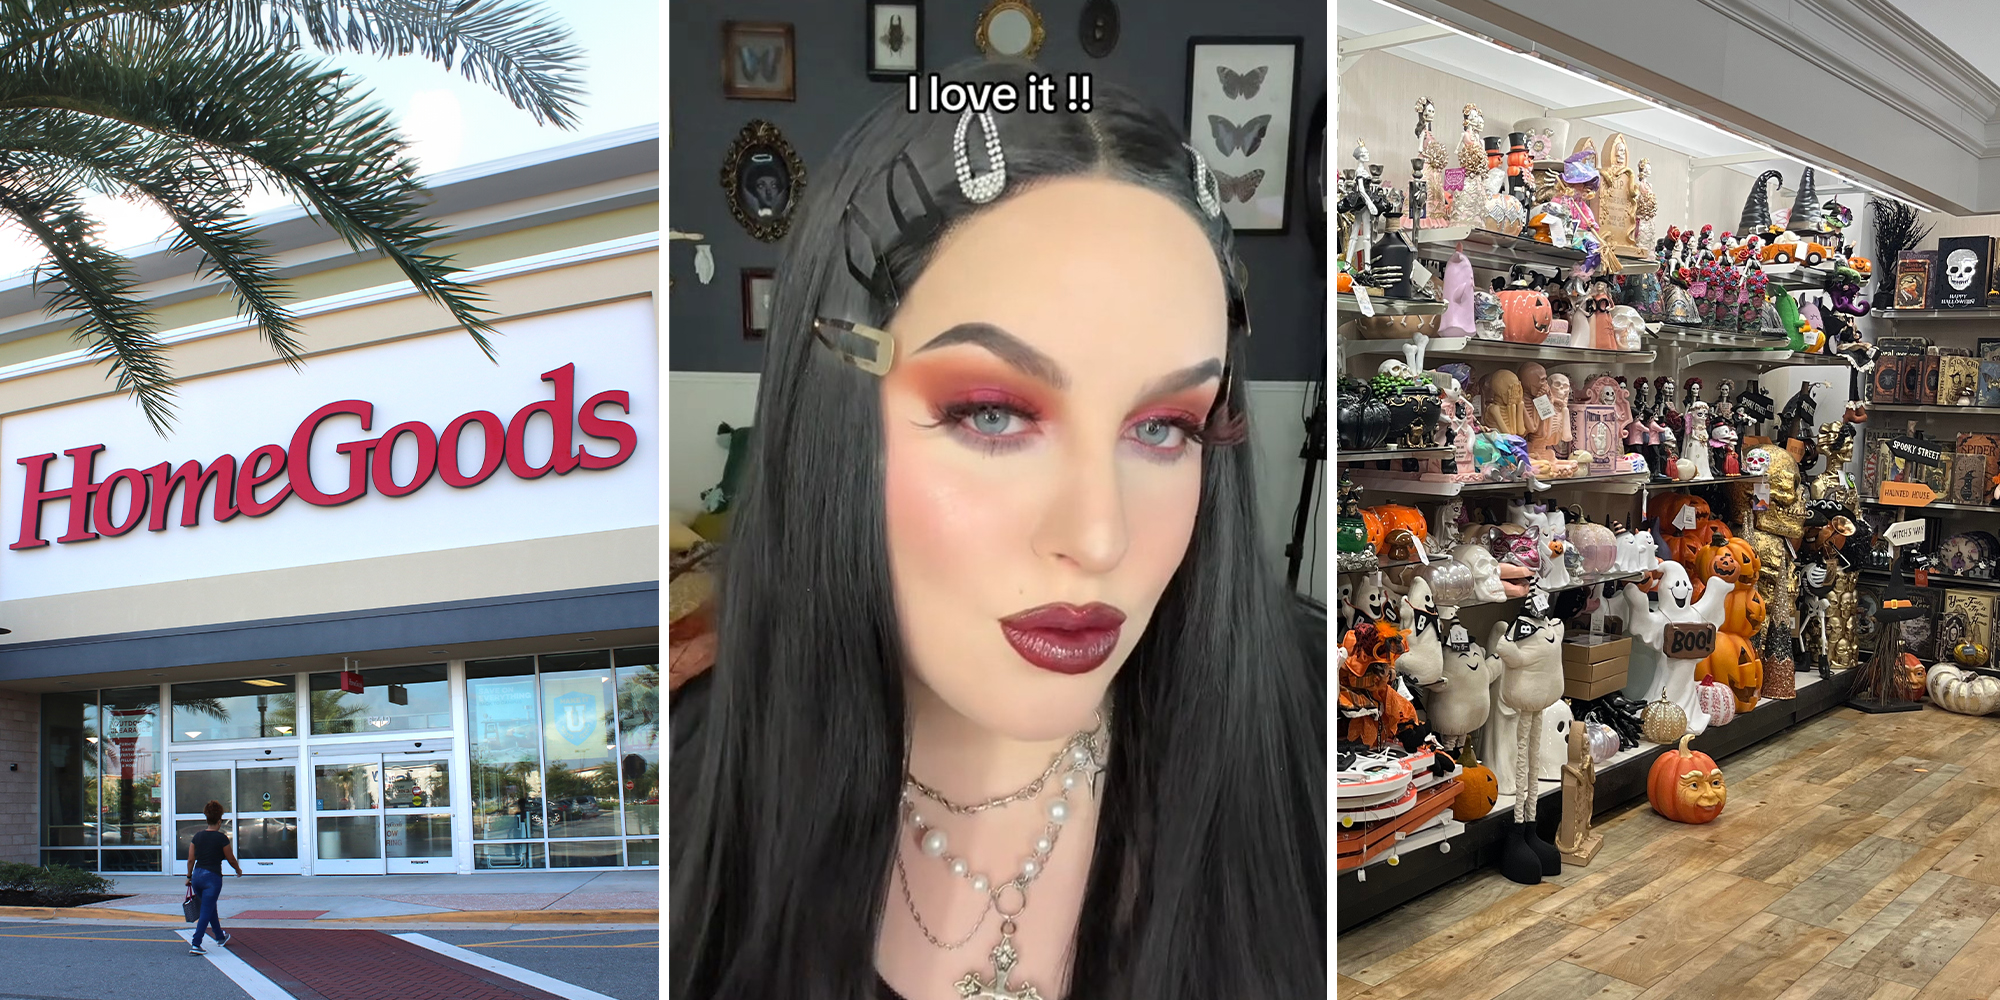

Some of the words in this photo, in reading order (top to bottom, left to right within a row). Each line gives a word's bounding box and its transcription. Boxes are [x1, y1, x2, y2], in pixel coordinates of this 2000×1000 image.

[1941, 298, 1976, 308] HALLOWEEN
[9, 361, 639, 550] HomeGoods
[1892, 440, 1917, 455] SPOOKY
[1917, 446, 1940, 461] STREET
[1961, 444, 1996, 457] SPIDER
[1885, 489, 1909, 498] HAUNTED
[1911, 490, 1931, 500] HOUSE
[1892, 527, 1912, 540] WITCH'S
[1416, 614, 1427, 631] B
[1520, 624, 1532, 634] B
[1671, 628, 1713, 654] BOO!
[478, 686, 500, 695] SAVE
[478, 692, 532, 702] EVERYTHING
[560, 697, 579, 705] MAKE
[563, 704, 585, 733] U
